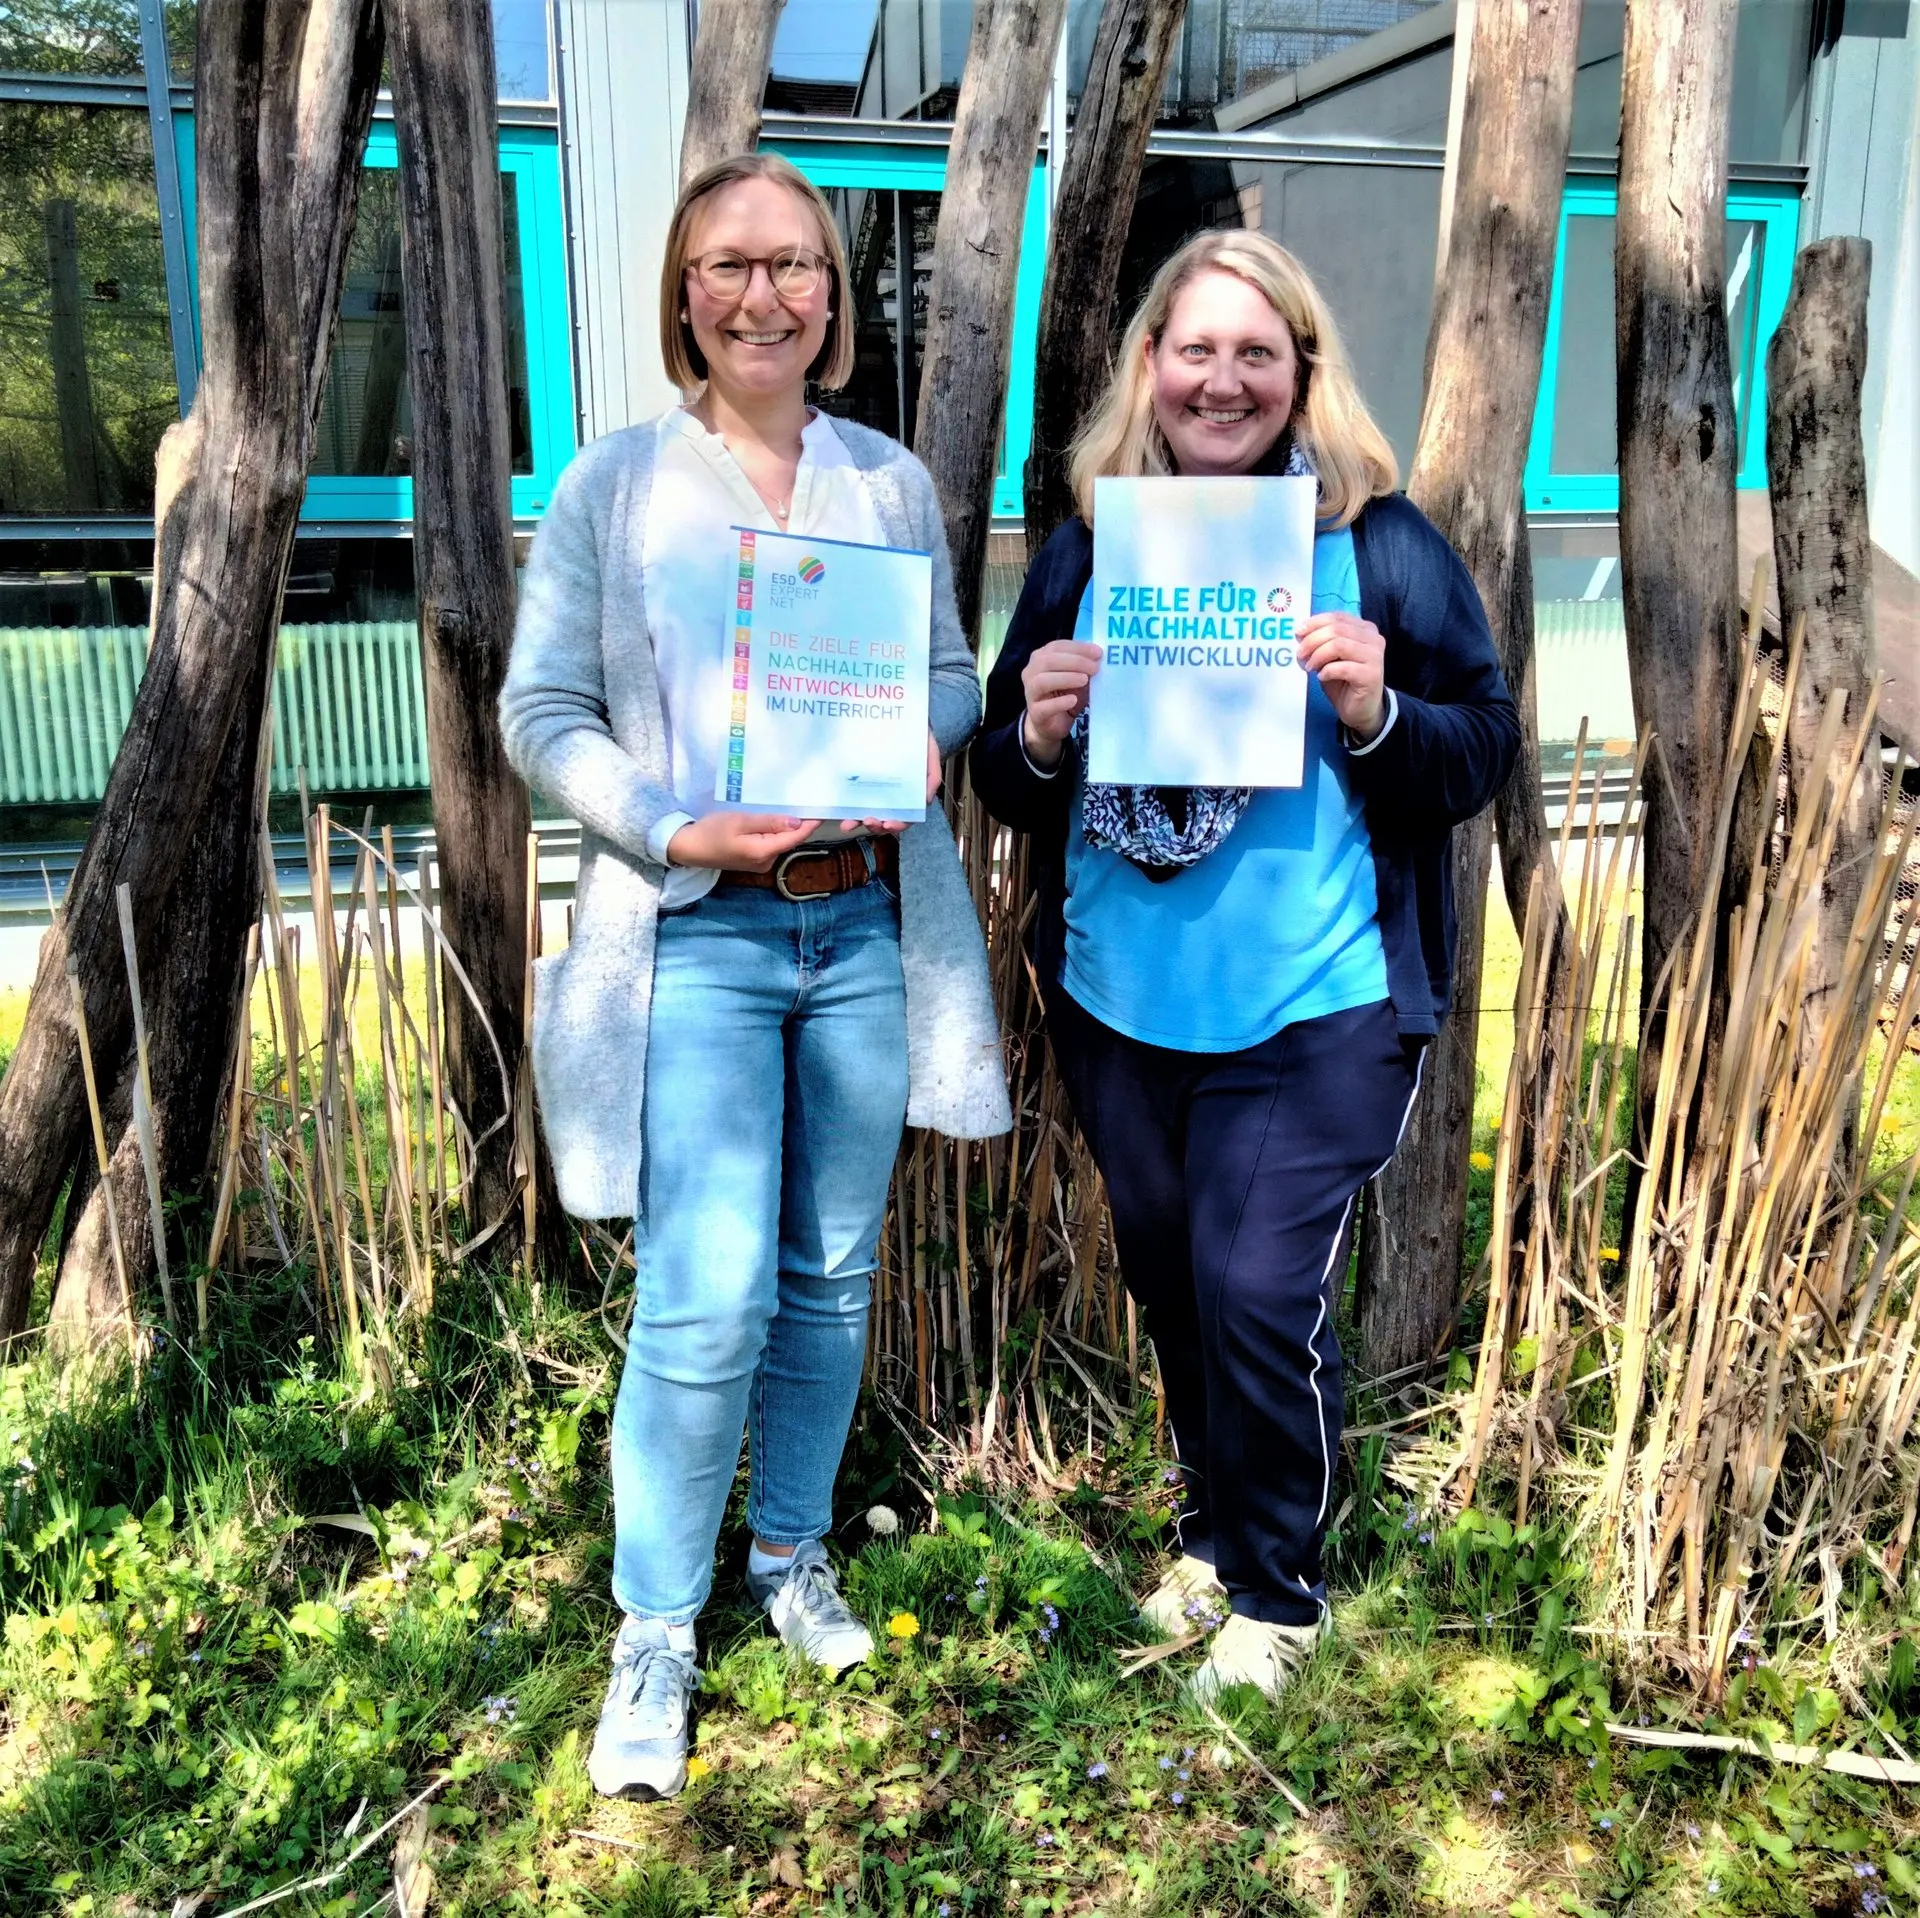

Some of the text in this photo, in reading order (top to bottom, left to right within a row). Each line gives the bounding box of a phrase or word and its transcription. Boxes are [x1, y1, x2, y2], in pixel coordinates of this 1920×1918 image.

[771, 572, 796, 586] ESD
[769, 595, 794, 609] NET
[770, 584, 819, 600] EXPERT
[1108, 581, 1256, 613] ZIELE FÜR
[1107, 615, 1294, 640] NACHHALTIGE
[769, 631, 905, 660] DIE ZIELE FÜR
[1106, 645, 1293, 667] ENTWICKLUNG
[768, 652, 905, 680] NACHHALTIGE
[767, 674, 904, 700] ENTWICKLUNG
[766, 695, 905, 720] IM UNTERRICHT
